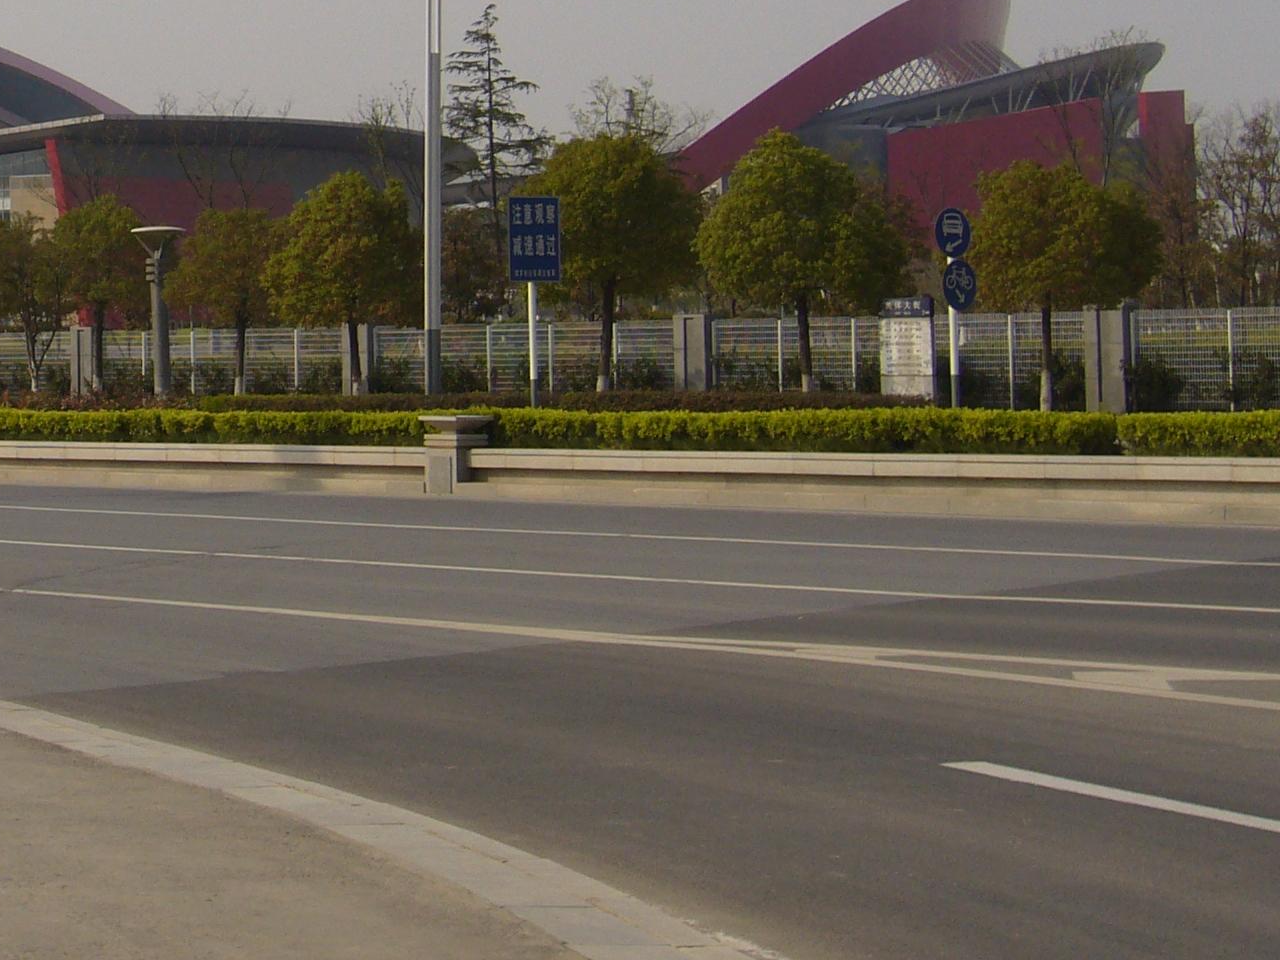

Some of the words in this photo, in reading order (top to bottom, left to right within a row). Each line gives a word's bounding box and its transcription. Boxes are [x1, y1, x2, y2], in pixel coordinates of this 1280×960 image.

[512, 203, 555, 225] 注意观察
[512, 234, 556, 257] 减速通过
